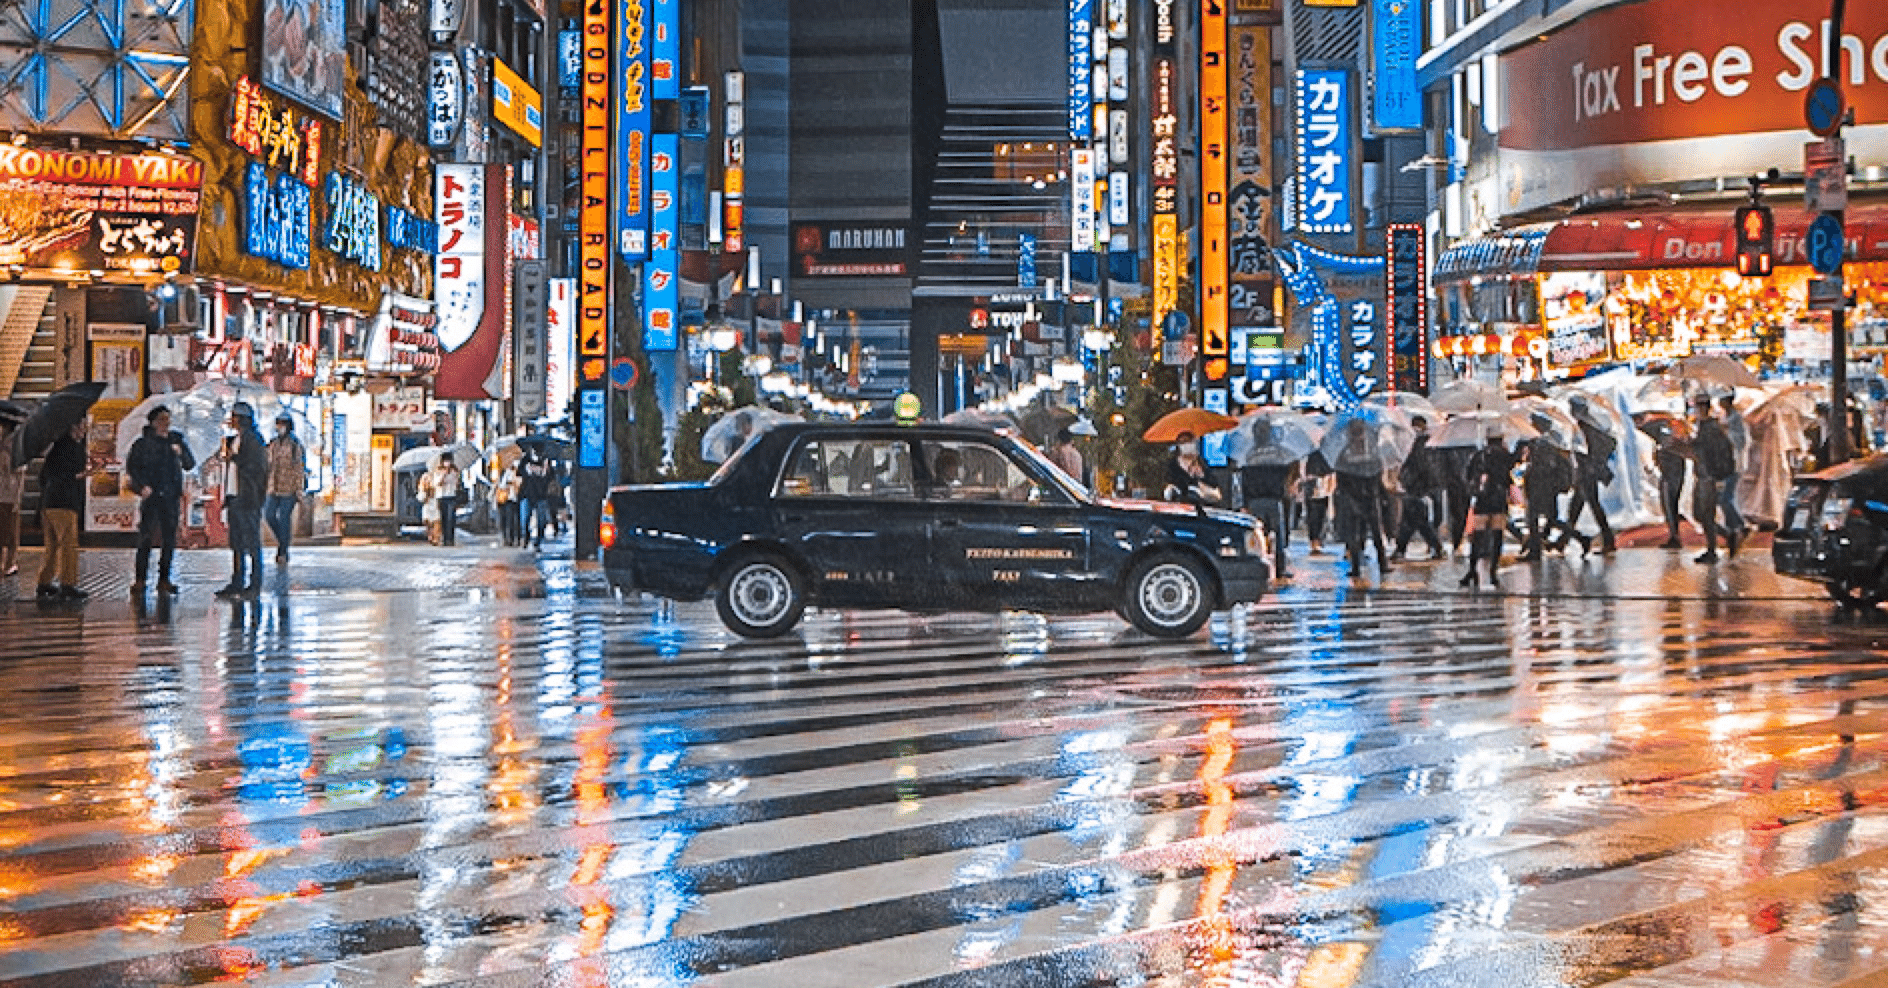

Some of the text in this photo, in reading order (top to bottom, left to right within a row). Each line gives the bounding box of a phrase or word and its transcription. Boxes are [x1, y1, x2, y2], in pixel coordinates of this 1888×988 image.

[1572, 62, 1621, 123] Tax
[1633, 43, 1753, 108] Free
[1307, 77, 1344, 222] カラオケ
[132, 154, 201, 184] YAKI
[585, 23, 605, 319] GODZILLA ROAD
[63, 197, 98, 210] Drinks
[101, 198, 116, 210] for
[118, 199, 126, 211] 2
[102, 186, 126, 198] with
[440, 175, 465, 279] トラノコ
[829, 228, 905, 249] MARUHAN
[1664, 237, 1723, 260] Don
[1230, 284, 1259, 309] 2F
[1393, 234, 1418, 350] カラオケ
[1351, 300, 1378, 397] カラオケ
[378, 403, 419, 414] トラノコ
